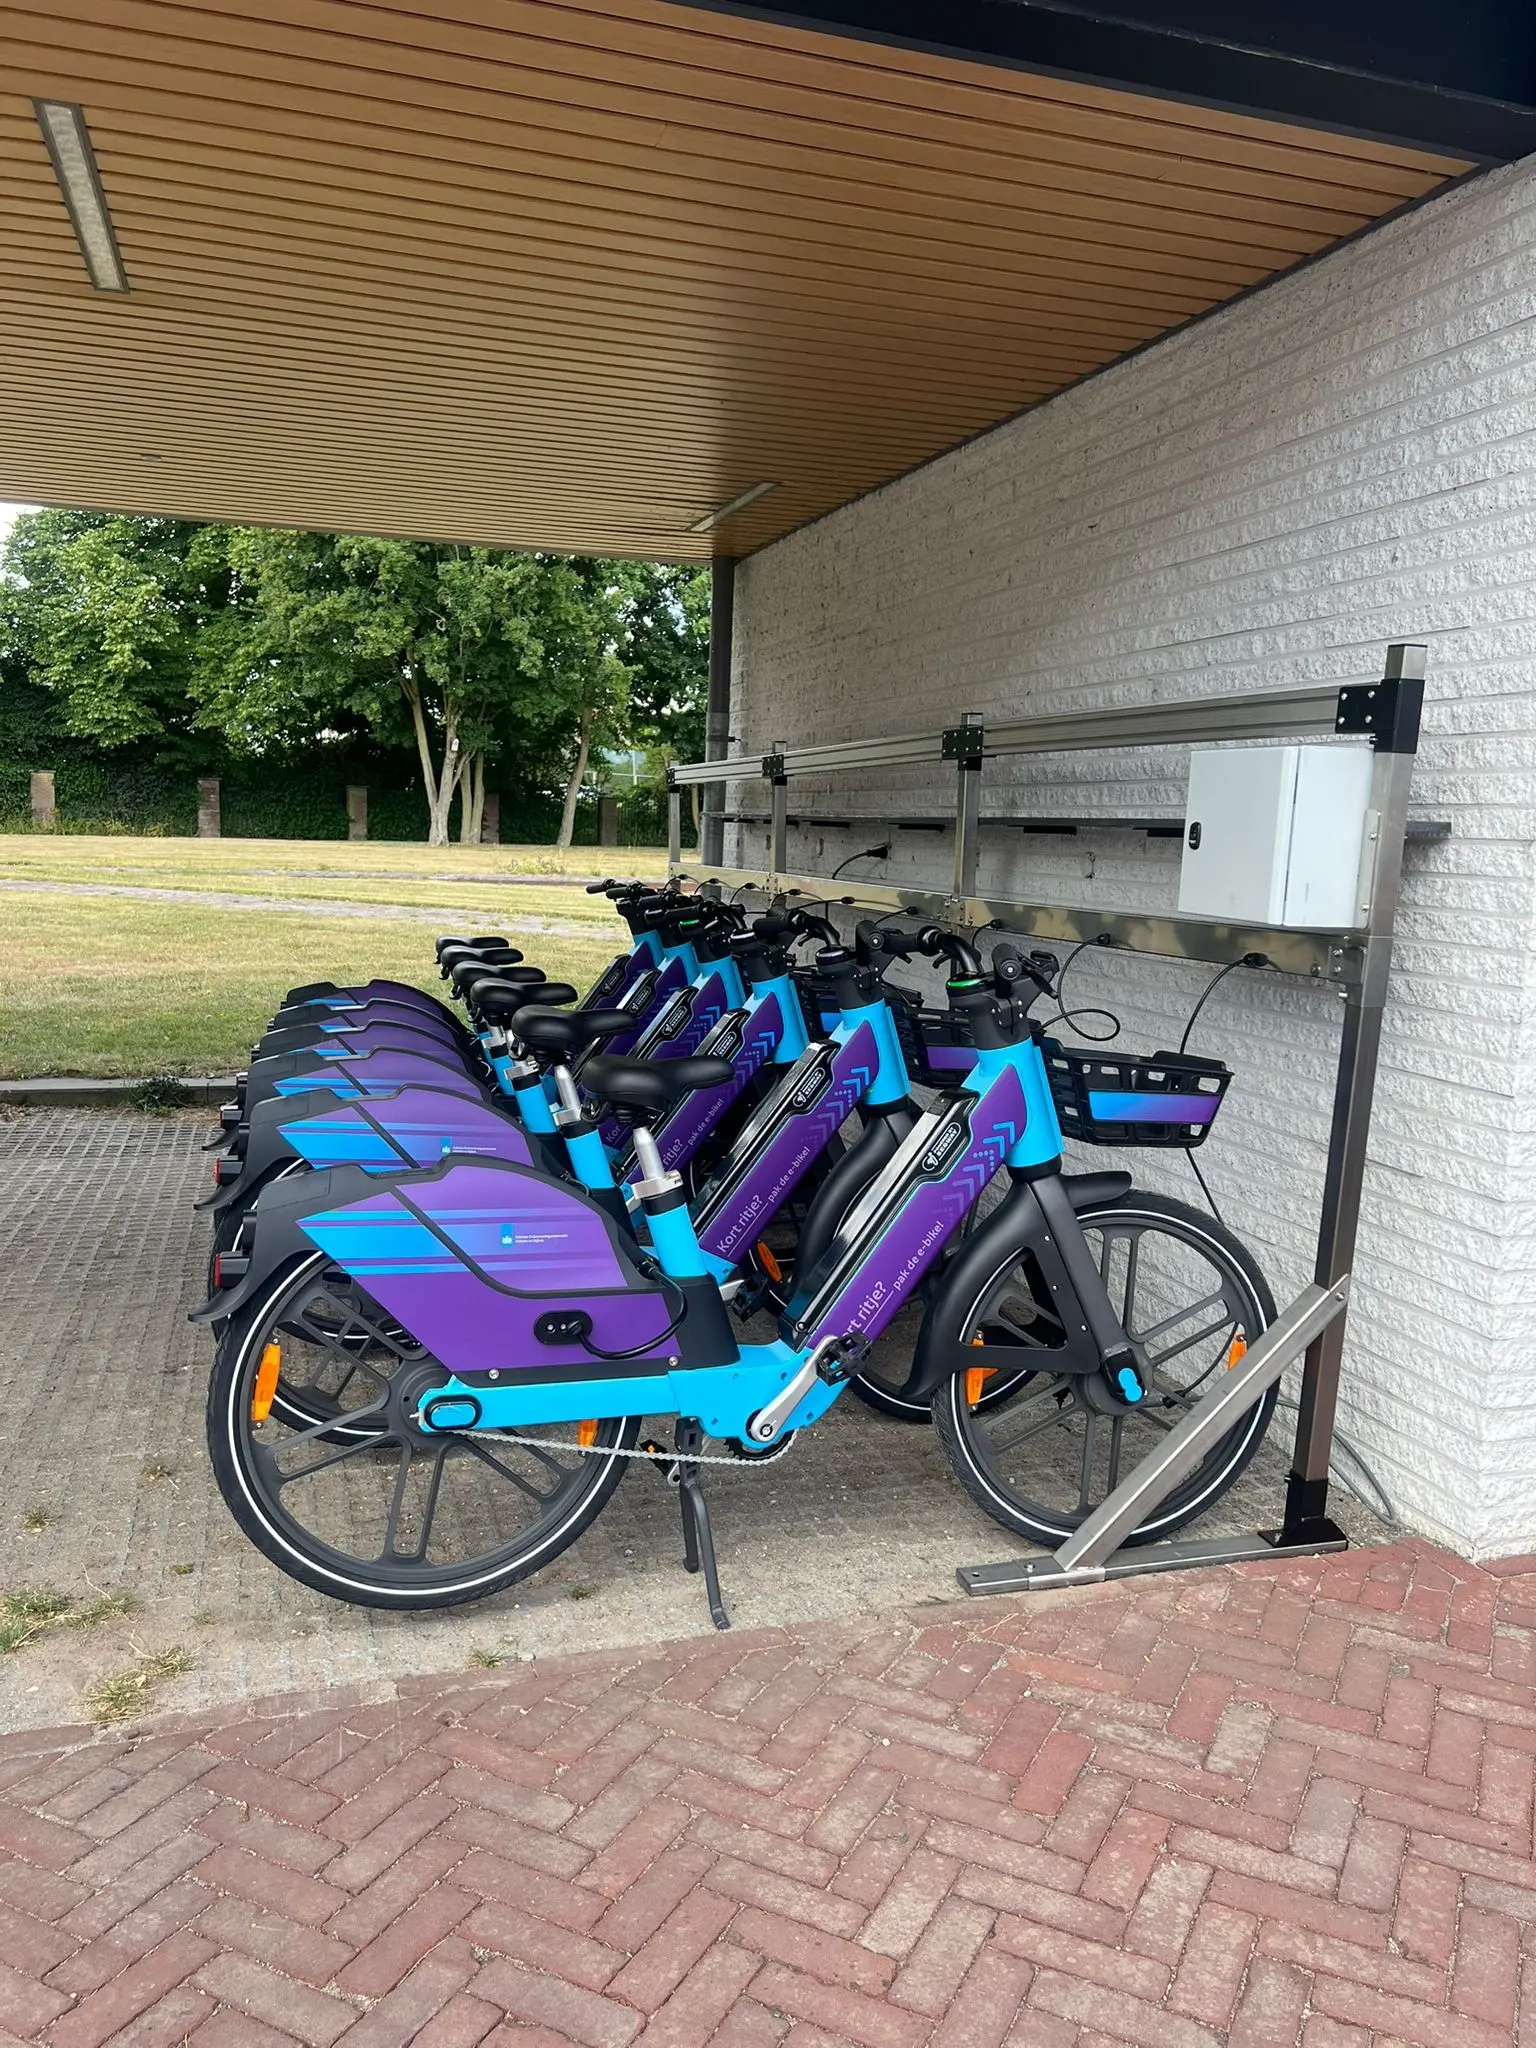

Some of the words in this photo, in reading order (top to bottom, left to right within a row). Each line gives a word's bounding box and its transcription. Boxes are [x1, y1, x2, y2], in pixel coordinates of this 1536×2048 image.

[605, 1124, 621, 1142] Kor
[687, 1131, 700, 1146] pak
[698, 1121, 708, 1133] de
[936, 1128, 958, 1157] SEGWAY
[662, 1138, 685, 1166] ritje?
[768, 1186, 782, 1203] pak
[779, 1174, 790, 1187] de
[787, 1146, 811, 1176] e-bike!
[716, 1224, 742, 1253] Kort
[738, 1194, 763, 1226] ritje?
[893, 1270, 911, 1291] pak
[907, 1255, 920, 1271] de
[917, 1221, 945, 1256] e-bike!
[858, 1281, 887, 1320] ritje?
